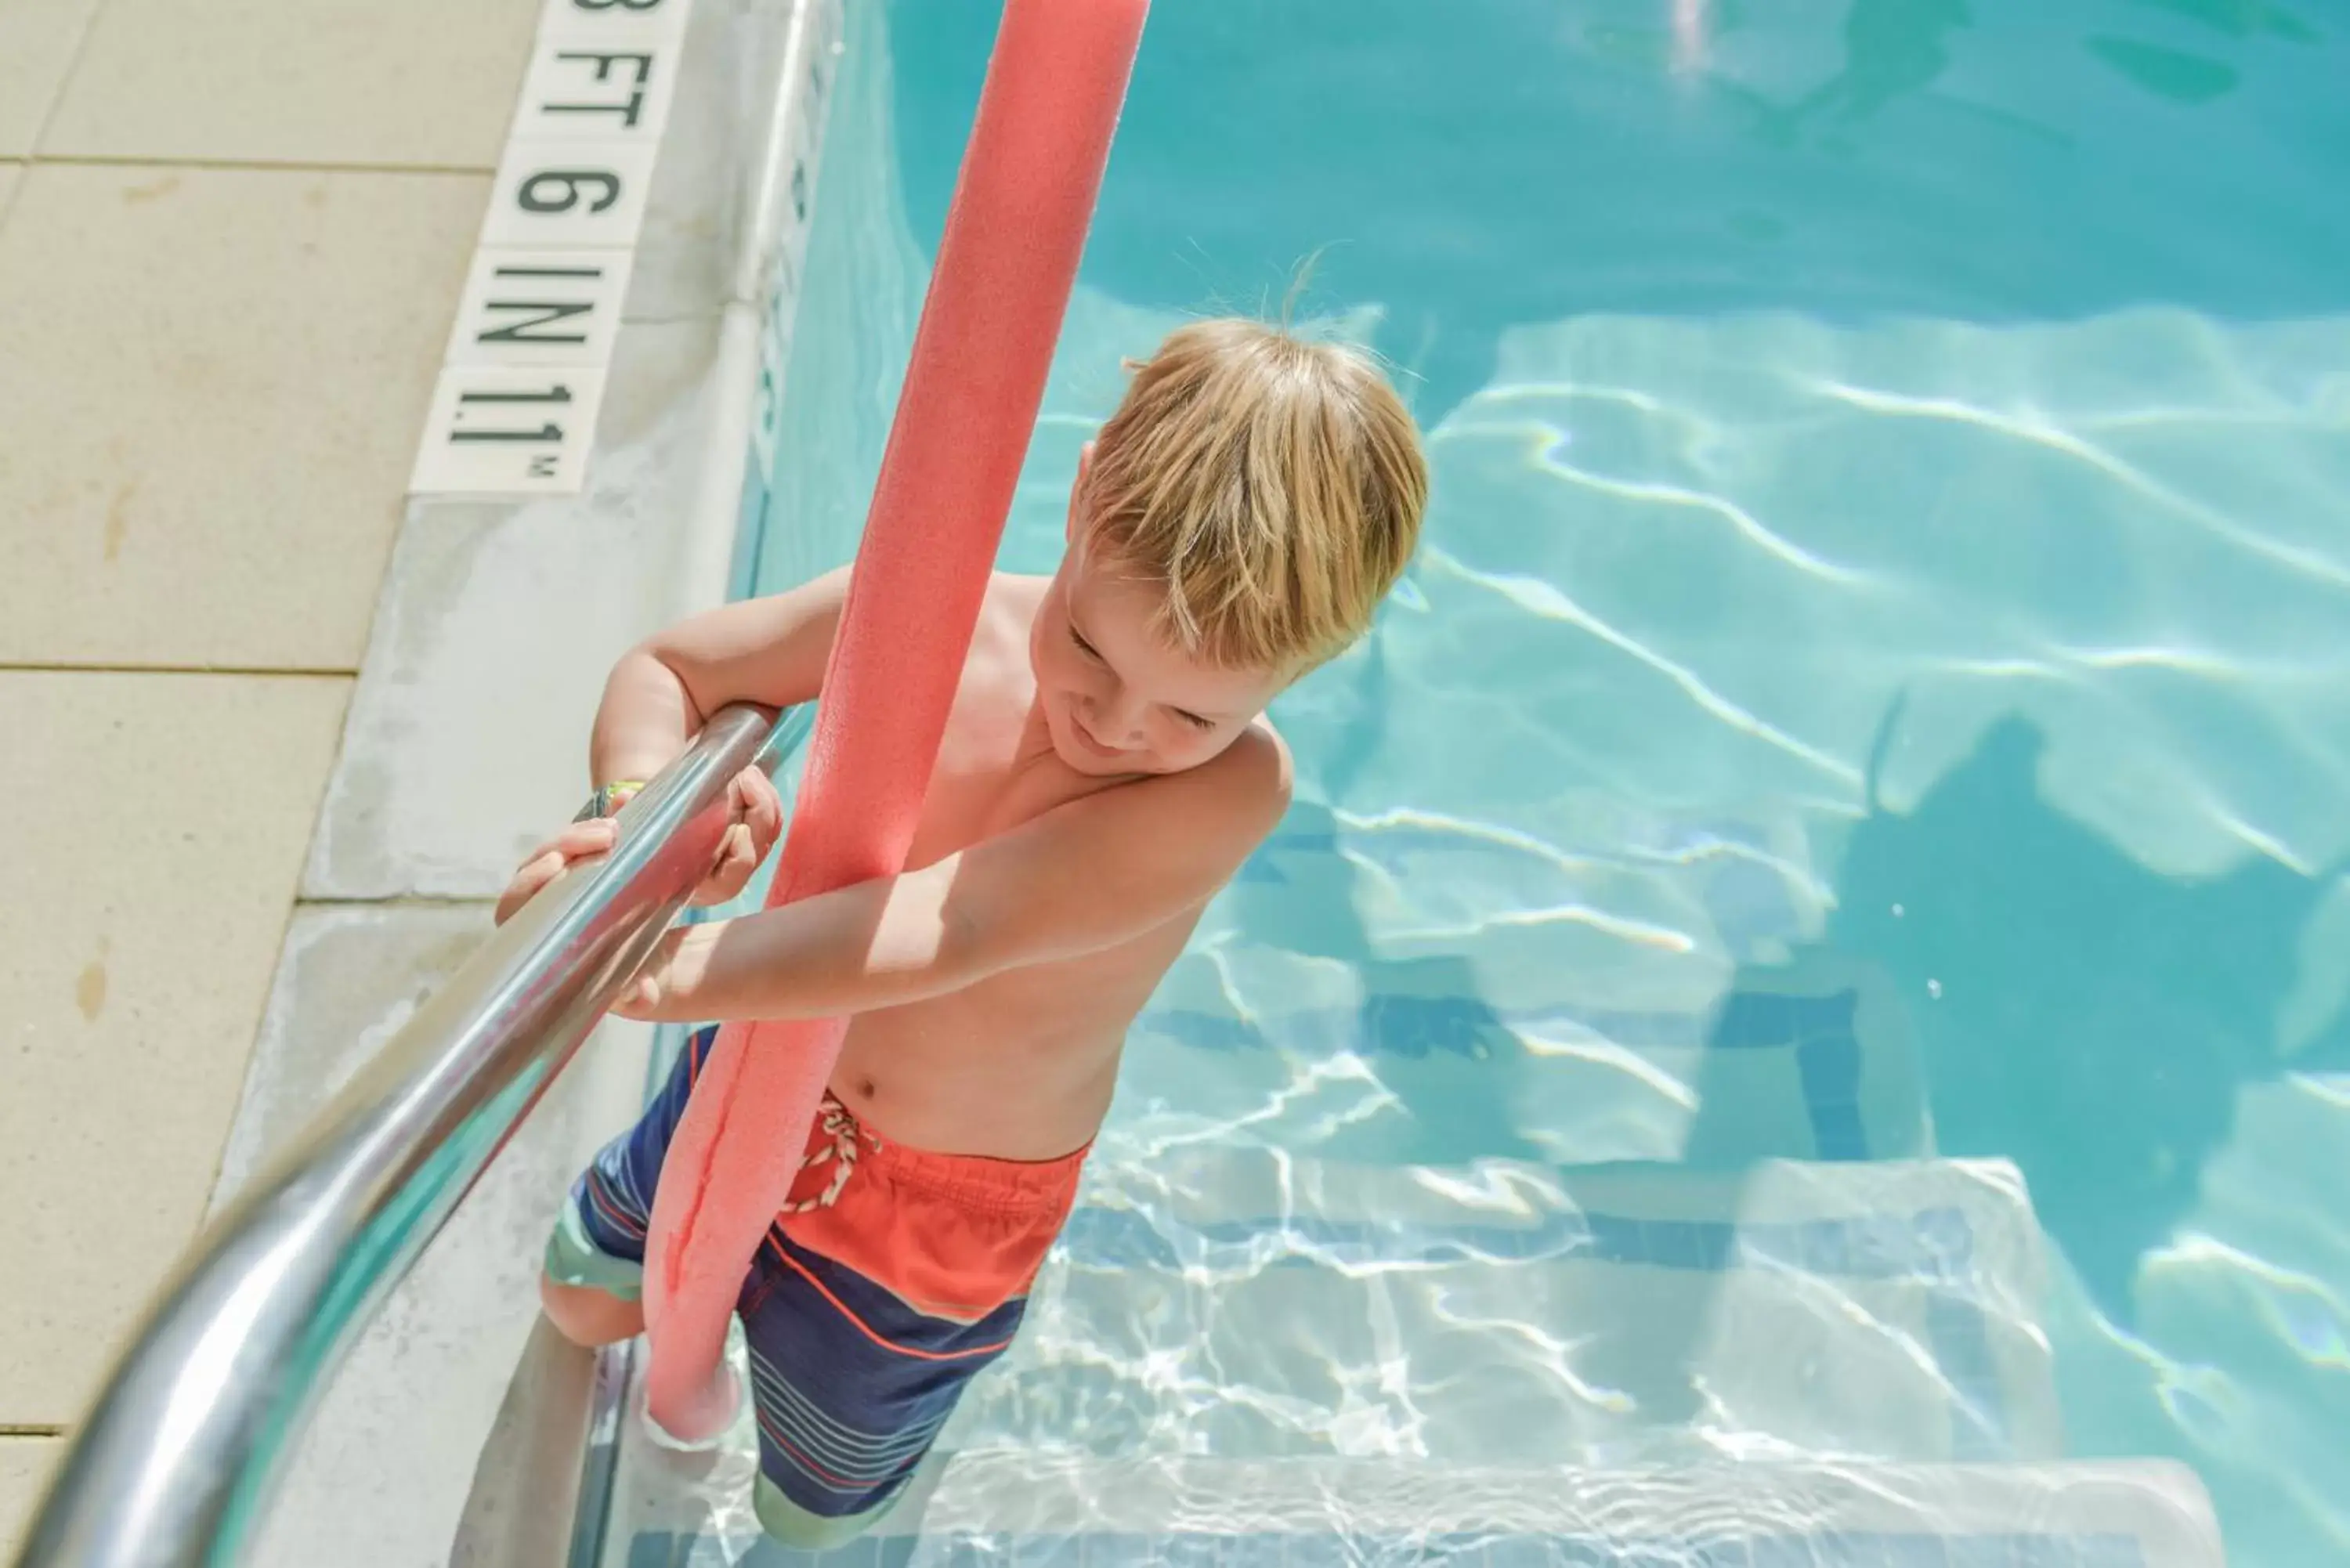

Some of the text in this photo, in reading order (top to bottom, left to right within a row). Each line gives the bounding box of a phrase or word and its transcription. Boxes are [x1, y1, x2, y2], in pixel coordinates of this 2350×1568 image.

[541, 52, 654, 128] FT
[517, 170, 621, 215] 6
[476, 267, 603, 345] IN
